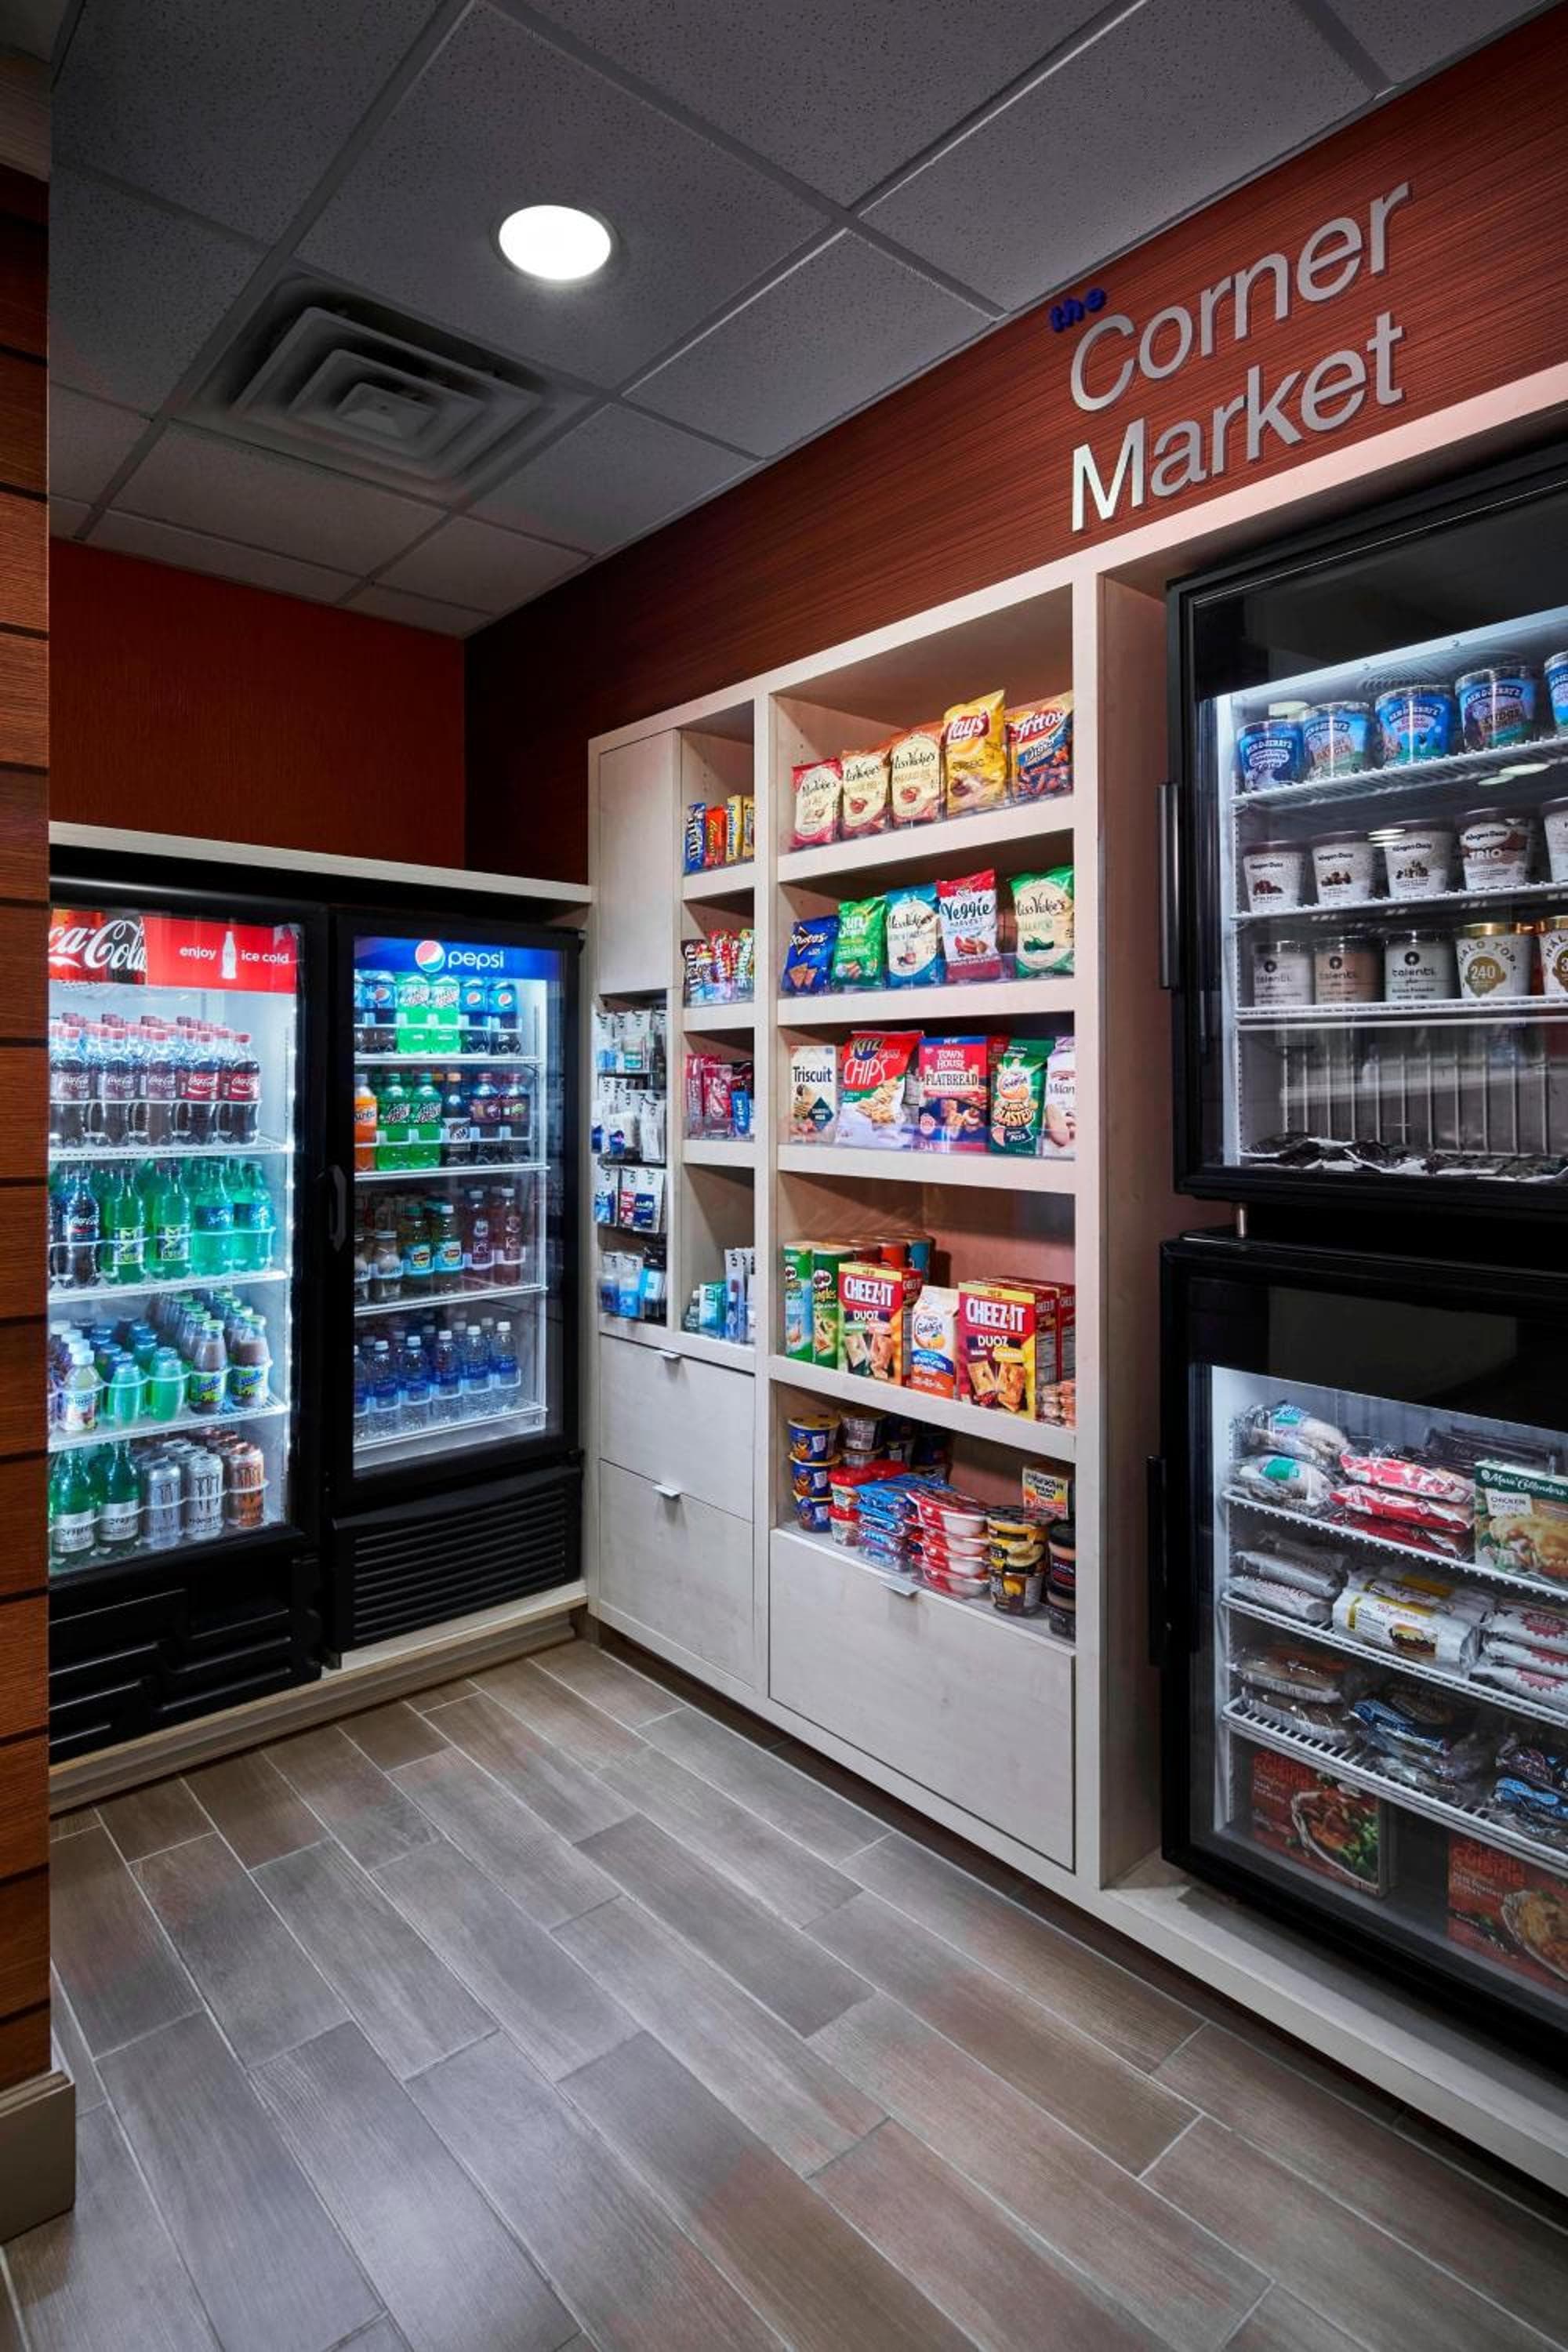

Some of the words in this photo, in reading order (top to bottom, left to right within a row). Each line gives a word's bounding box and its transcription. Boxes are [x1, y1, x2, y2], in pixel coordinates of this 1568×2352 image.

[1071, 182, 1409, 412] Corner
[1049, 288, 1107, 332] the
[1072, 312, 1403, 532] Market
[1469, 848, 1503, 860] TRIO
[942, 898, 992, 921] Veggie
[179, 946, 216, 960] enjoy
[241, 950, 260, 962] ice
[263, 953, 290, 964] cold
[447, 950, 505, 971] pepsi
[1392, 967, 1436, 978] talenti
[1470, 965, 1496, 979] 240
[937, 1048, 965, 1059] TOWN
[937, 1058, 965, 1070] HOUSE
[792, 1065, 833, 1083] Triscuit
[844, 1058, 888, 1085] CHIPS
[926, 1073, 978, 1087] FLATBREAD
[844, 1275, 895, 1307] CHEEZ-IT
[853, 1309, 880, 1321] DUOZ
[966, 1297, 1026, 1333] CHEEZ-IT
[978, 1335, 1009, 1348] DUOZ
[1491, 1496, 1526, 1506] CHICKEN
